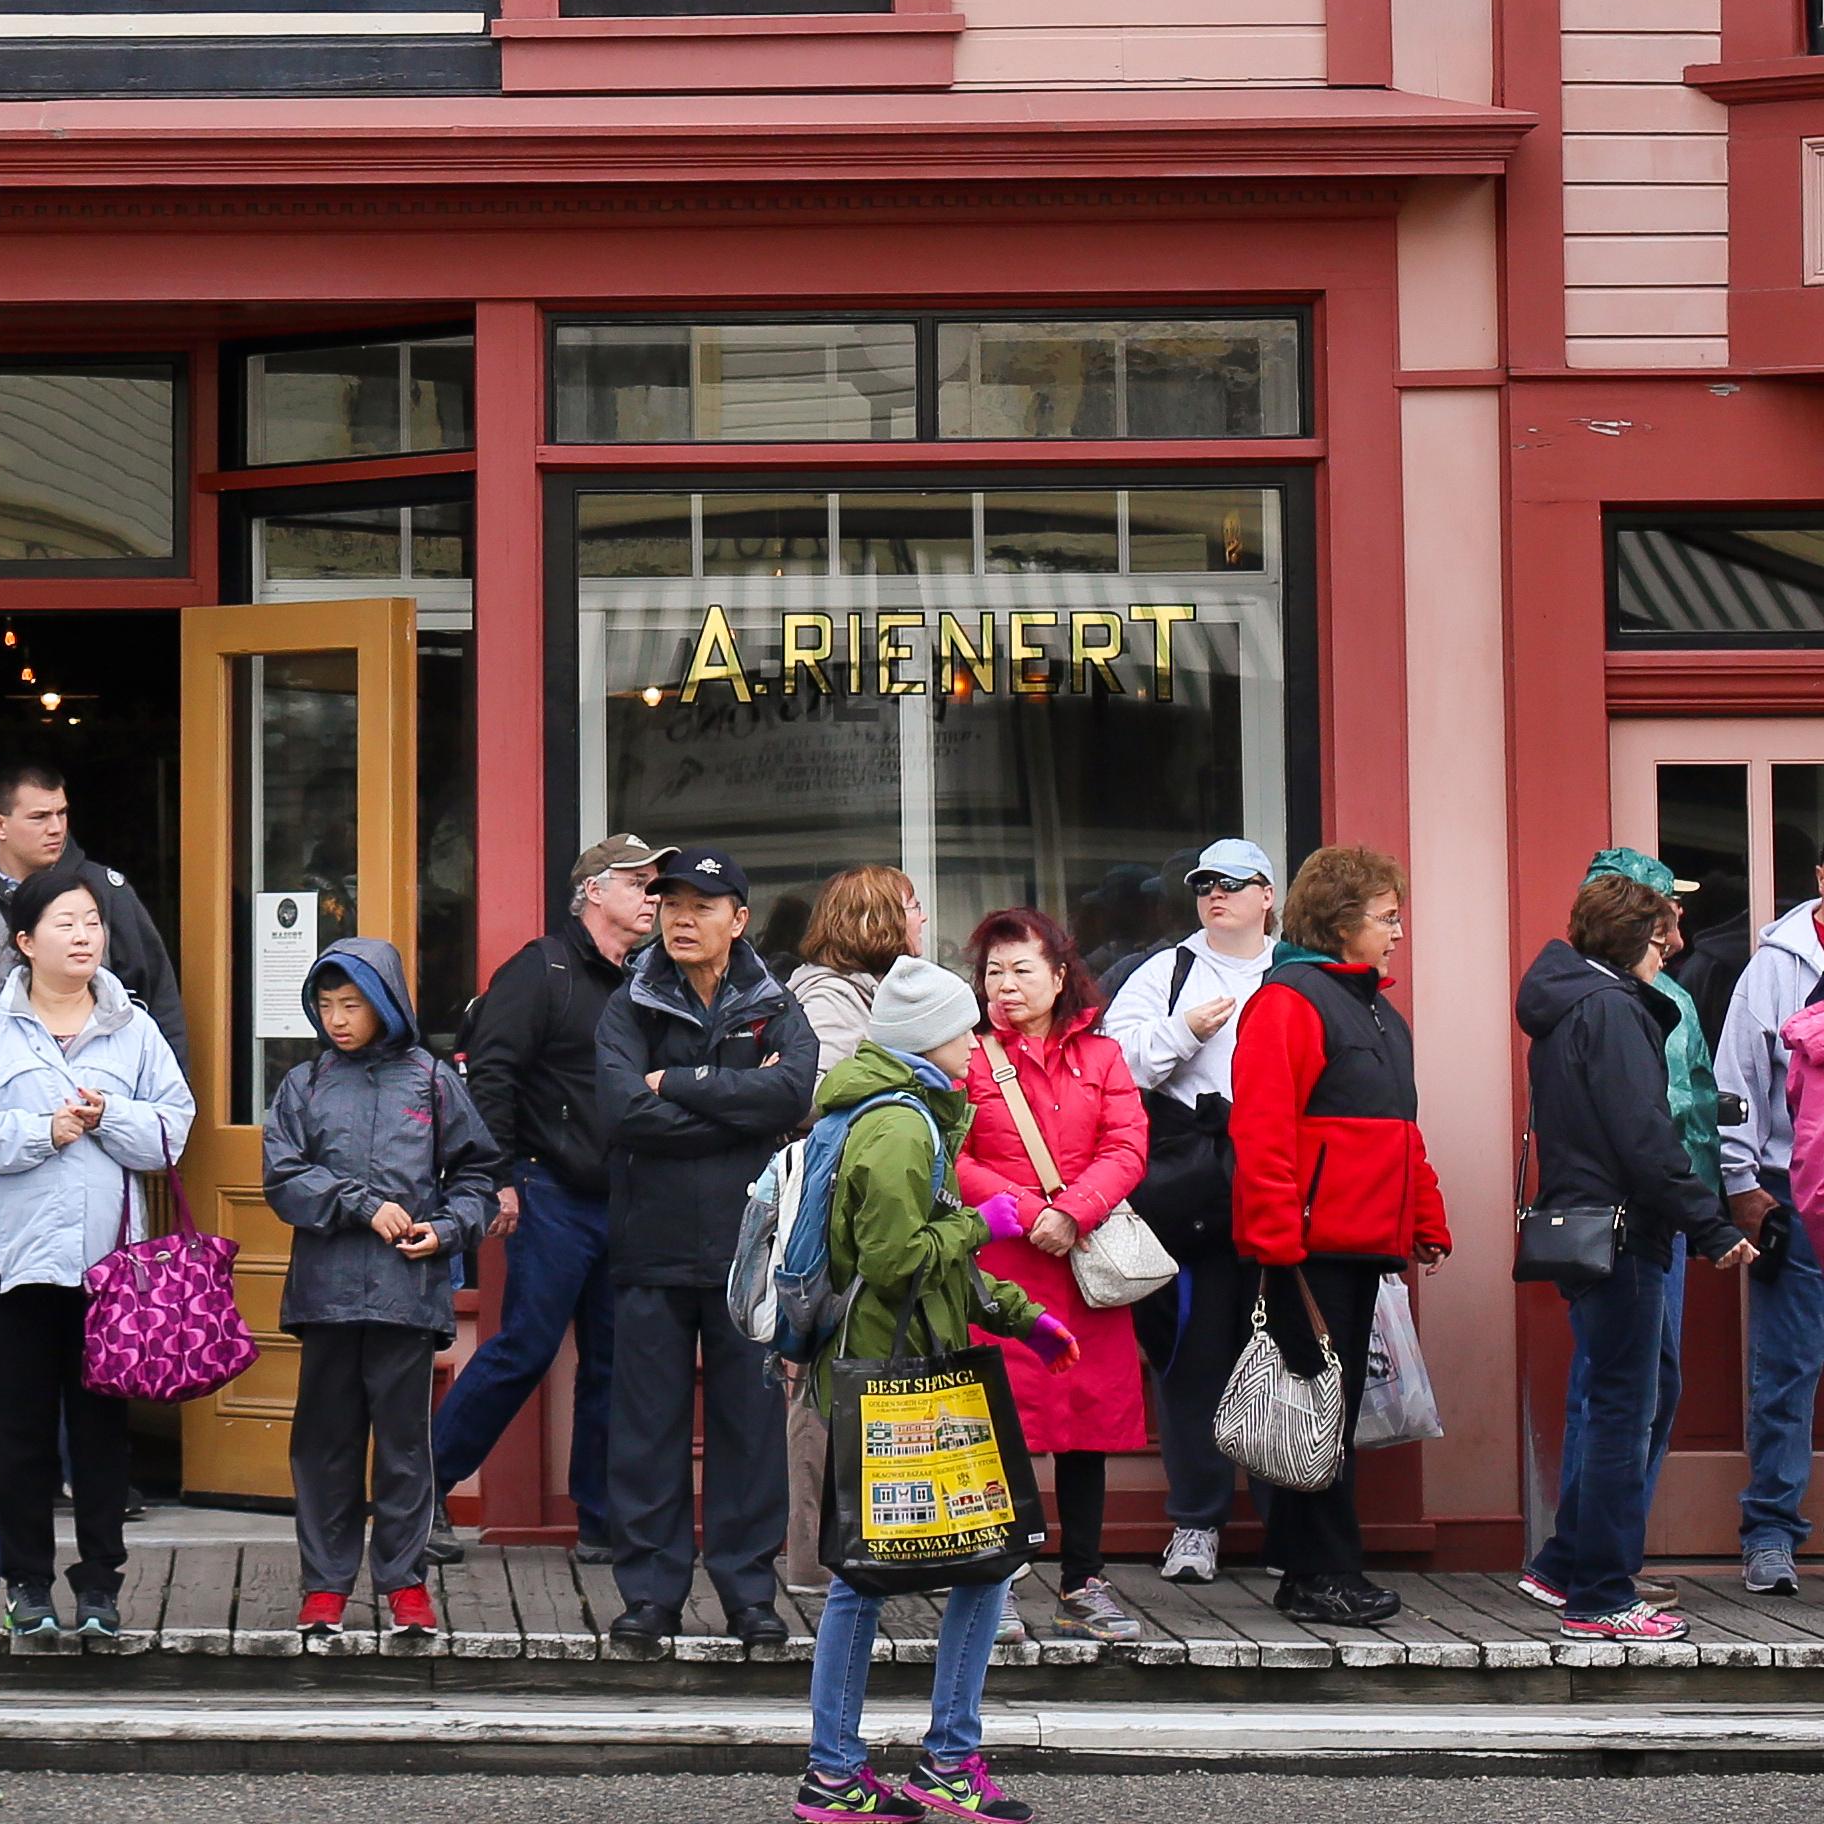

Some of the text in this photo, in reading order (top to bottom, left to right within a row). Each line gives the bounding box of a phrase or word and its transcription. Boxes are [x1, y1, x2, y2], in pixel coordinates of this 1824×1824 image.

[866, 1378, 911, 1394] BEST
[867, 1525, 1010, 1554] SKAGWAY, ALASKA
